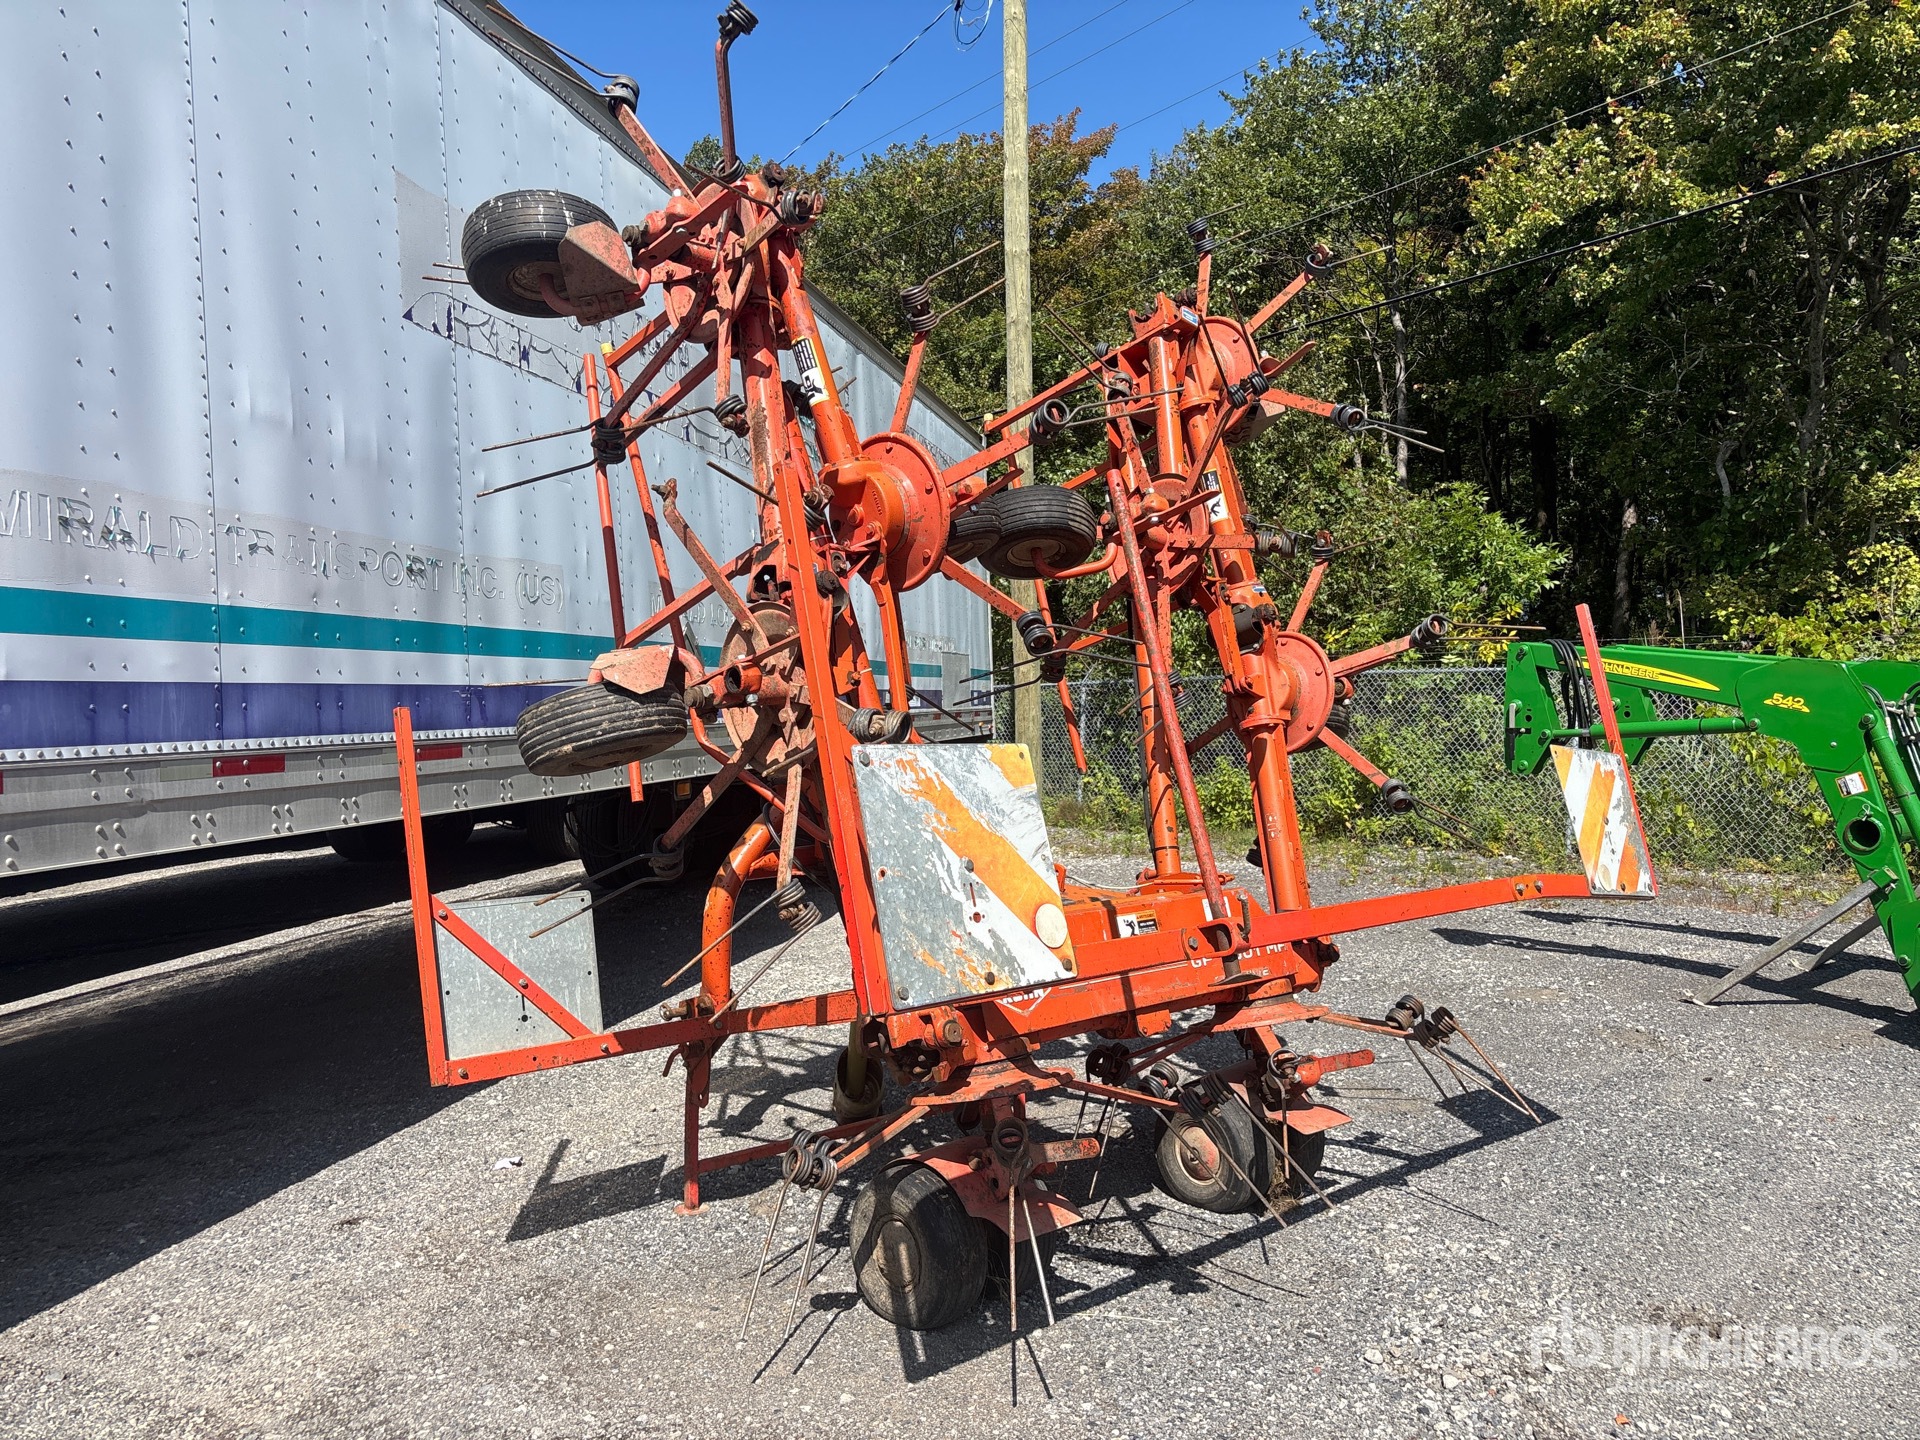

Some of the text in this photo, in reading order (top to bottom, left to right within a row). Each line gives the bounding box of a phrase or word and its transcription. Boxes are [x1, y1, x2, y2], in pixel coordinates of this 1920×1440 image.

[217, 523, 443, 592] TRANSPORT
[452, 561, 505, 599] INC.
[514, 571, 565, 613] (US)
[1772, 692, 1805, 710] 542
